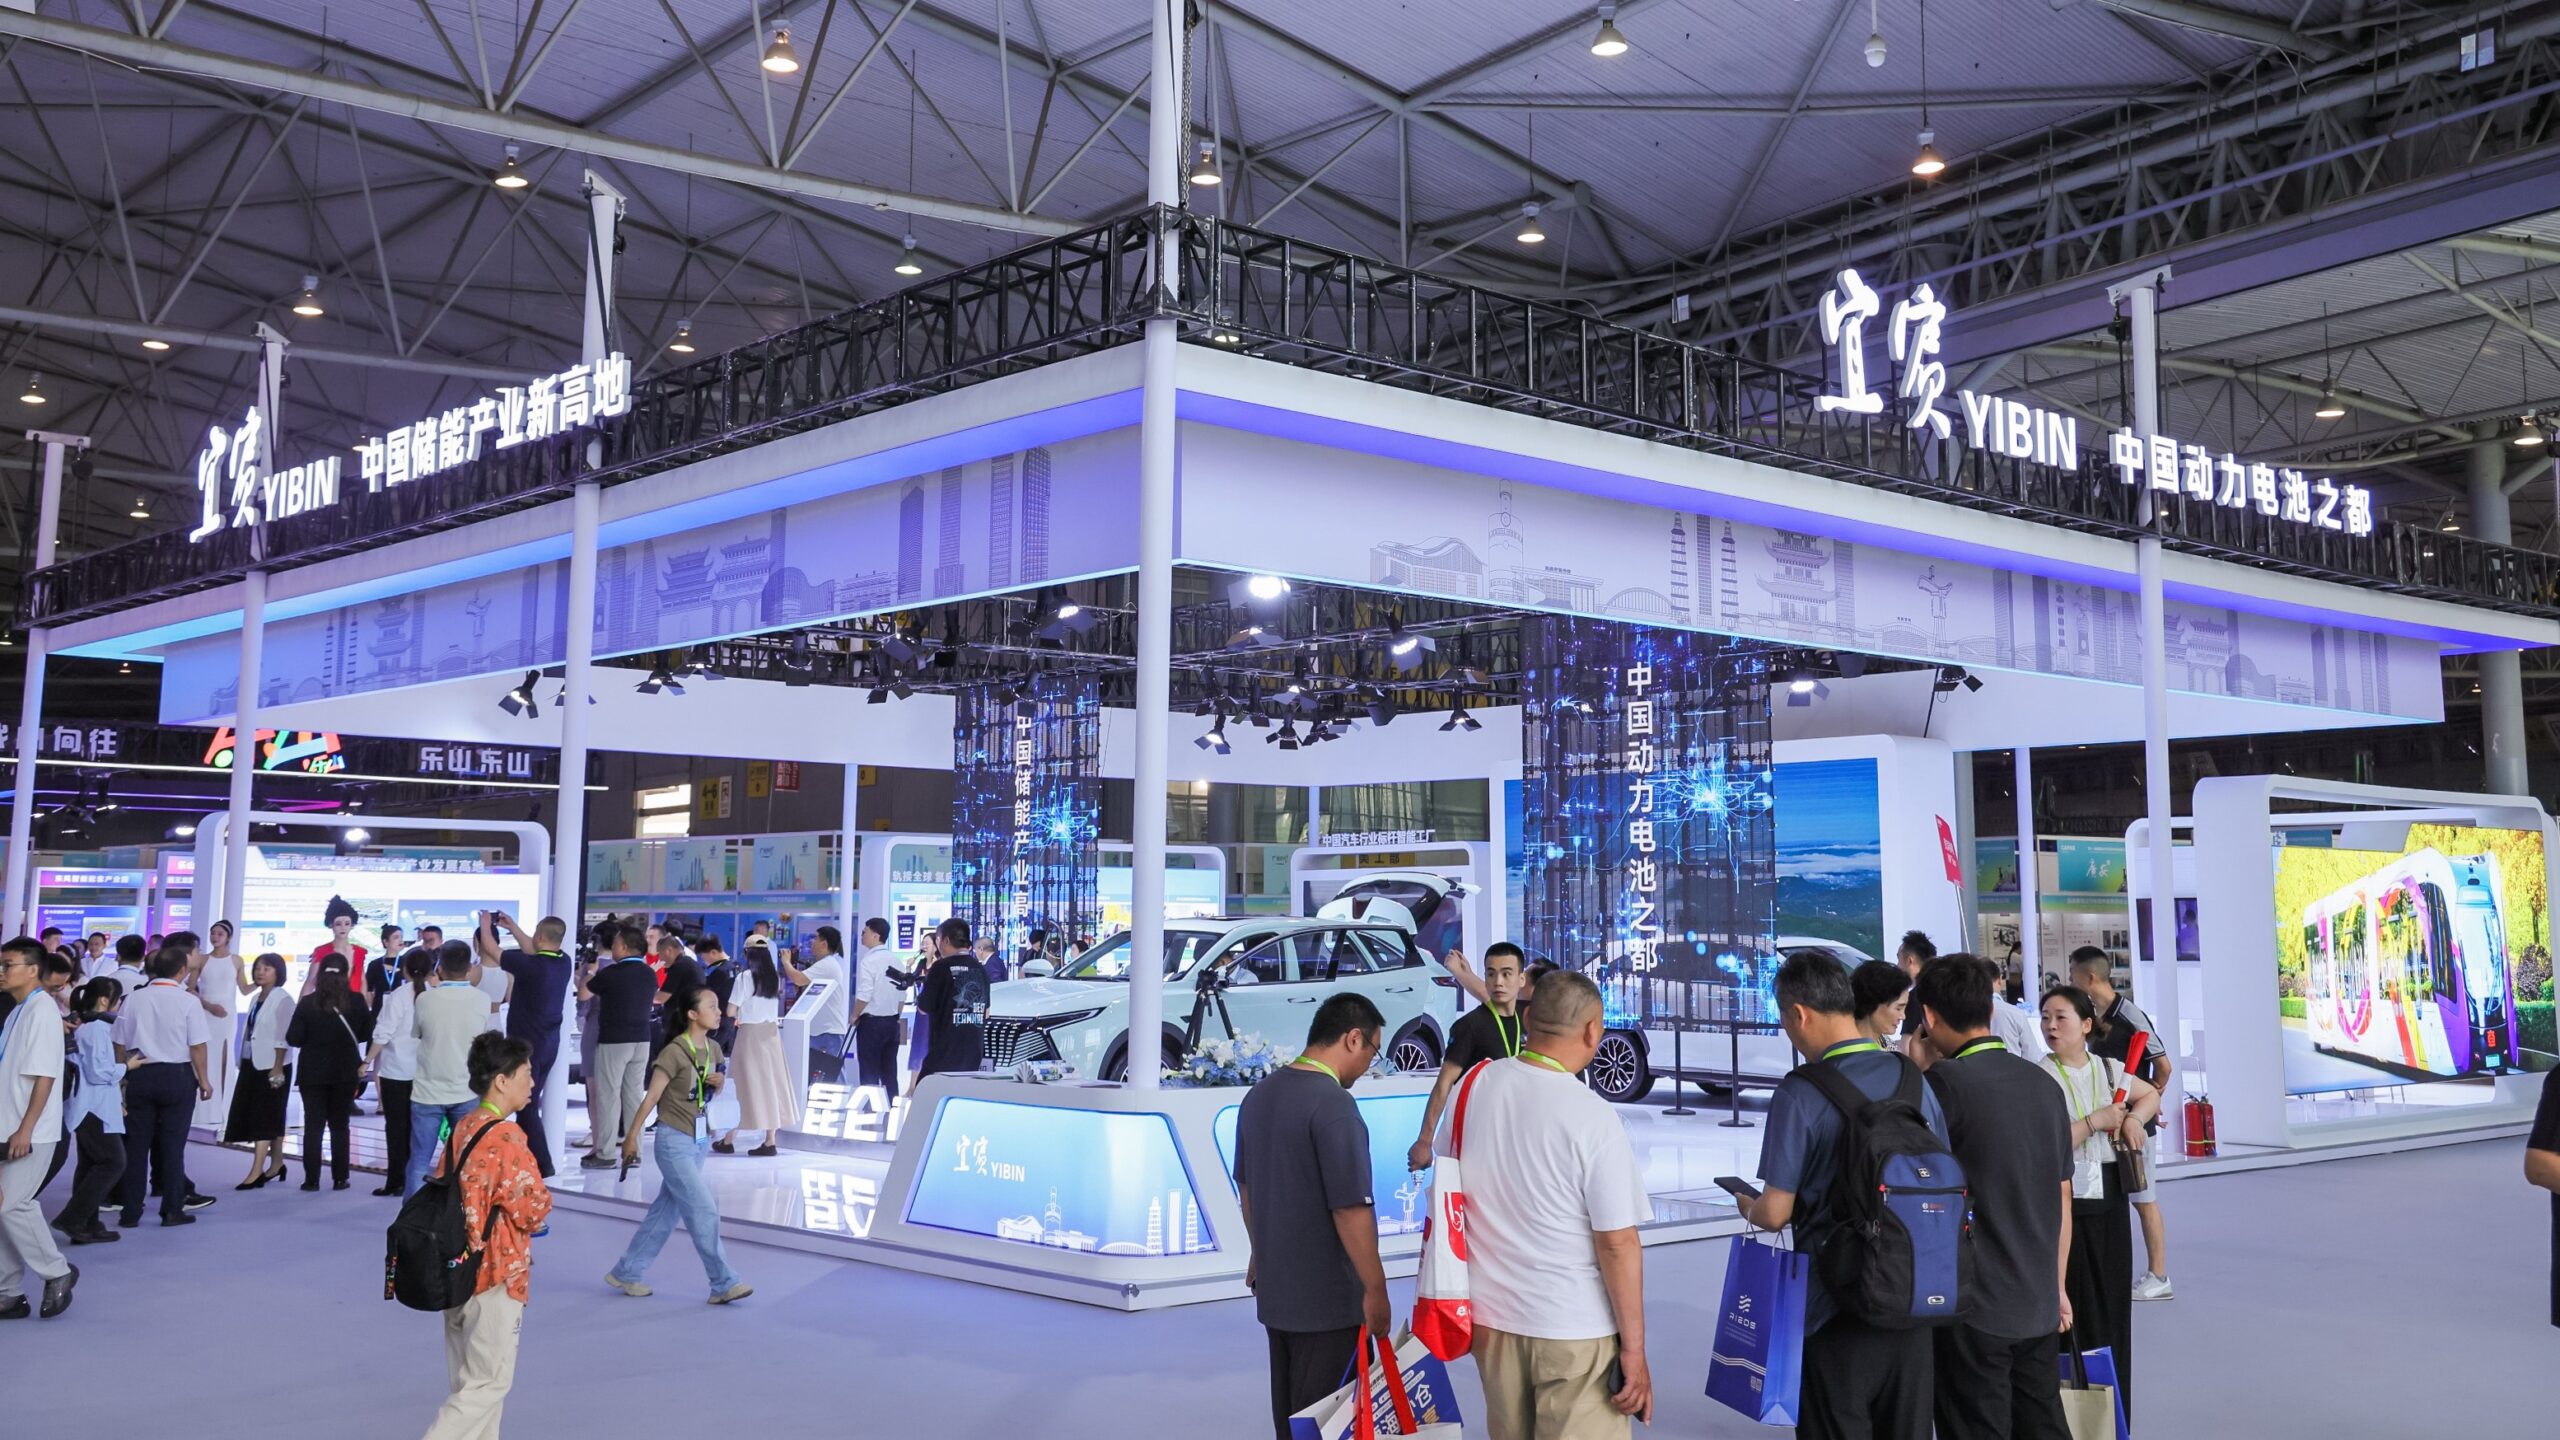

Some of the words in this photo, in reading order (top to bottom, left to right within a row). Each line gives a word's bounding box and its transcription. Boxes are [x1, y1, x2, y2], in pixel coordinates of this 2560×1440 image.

[1814, 269, 1951, 440] 宜宾
[361, 351, 632, 493] 中国储能产业新高地
[1957, 389, 2078, 471] YIBIN
[263, 455, 341, 521] YIBIN
[2109, 426, 2373, 537] 中国动力电池之都
[1013, 715, 1033, 950] 中国储能产业高地
[1626, 661, 1659, 973] 中国动力电池之都
[259, 933, 276, 947] 18
[990, 1162, 1025, 1182] YIBIN
